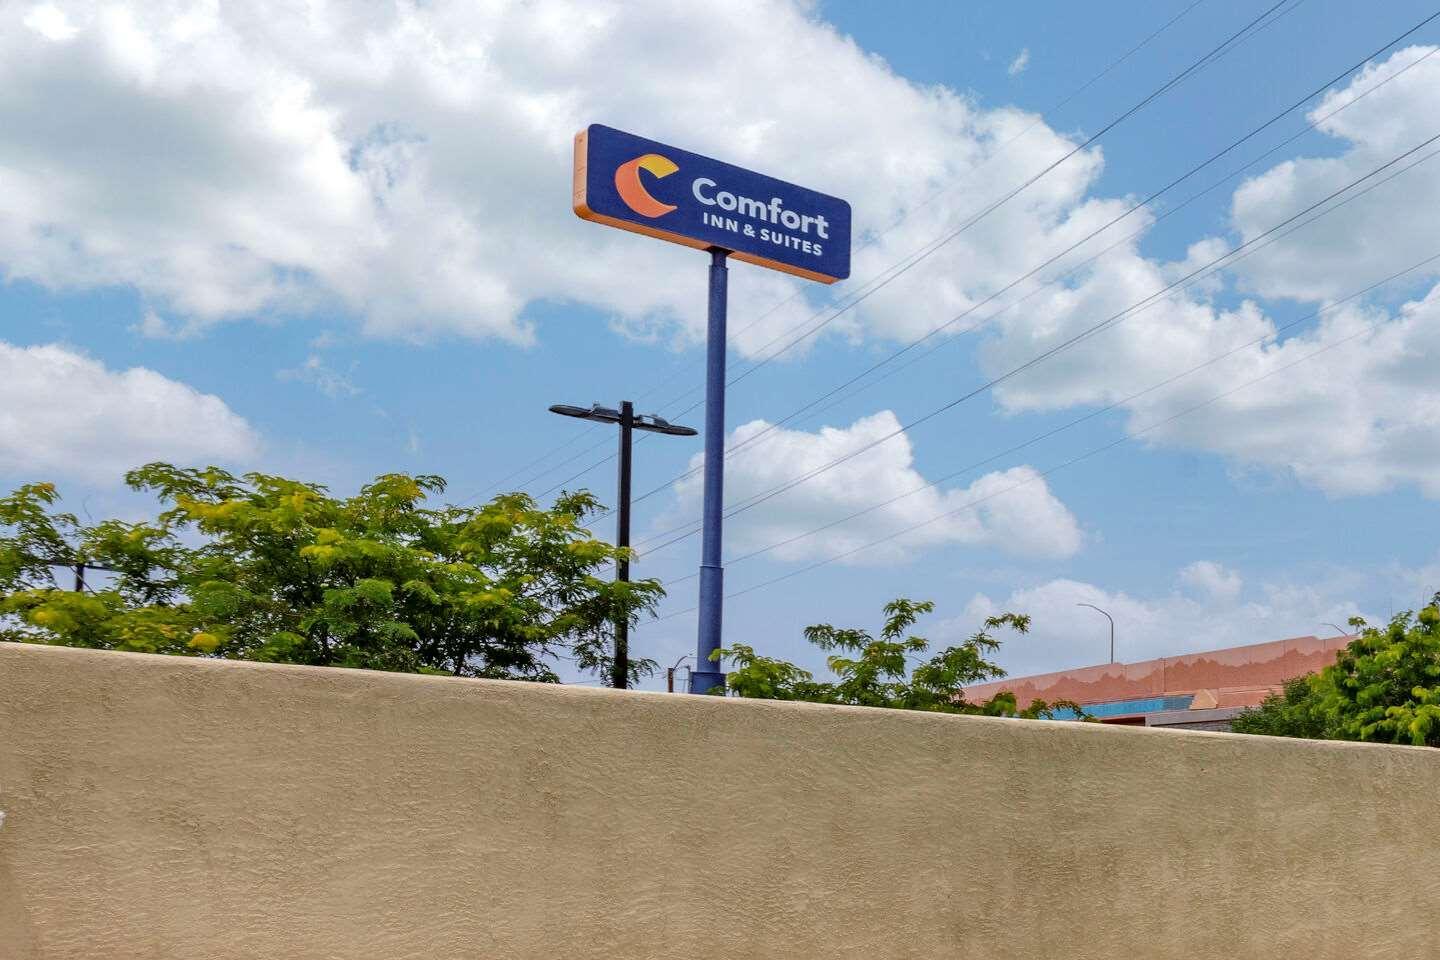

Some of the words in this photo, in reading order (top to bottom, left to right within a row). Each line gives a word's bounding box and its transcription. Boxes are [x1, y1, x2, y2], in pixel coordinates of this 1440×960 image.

[692, 177, 829, 239] Comfort
[703, 212, 738, 233] INN
[743, 224, 756, 238] &
[760, 228, 823, 256] SUITES
